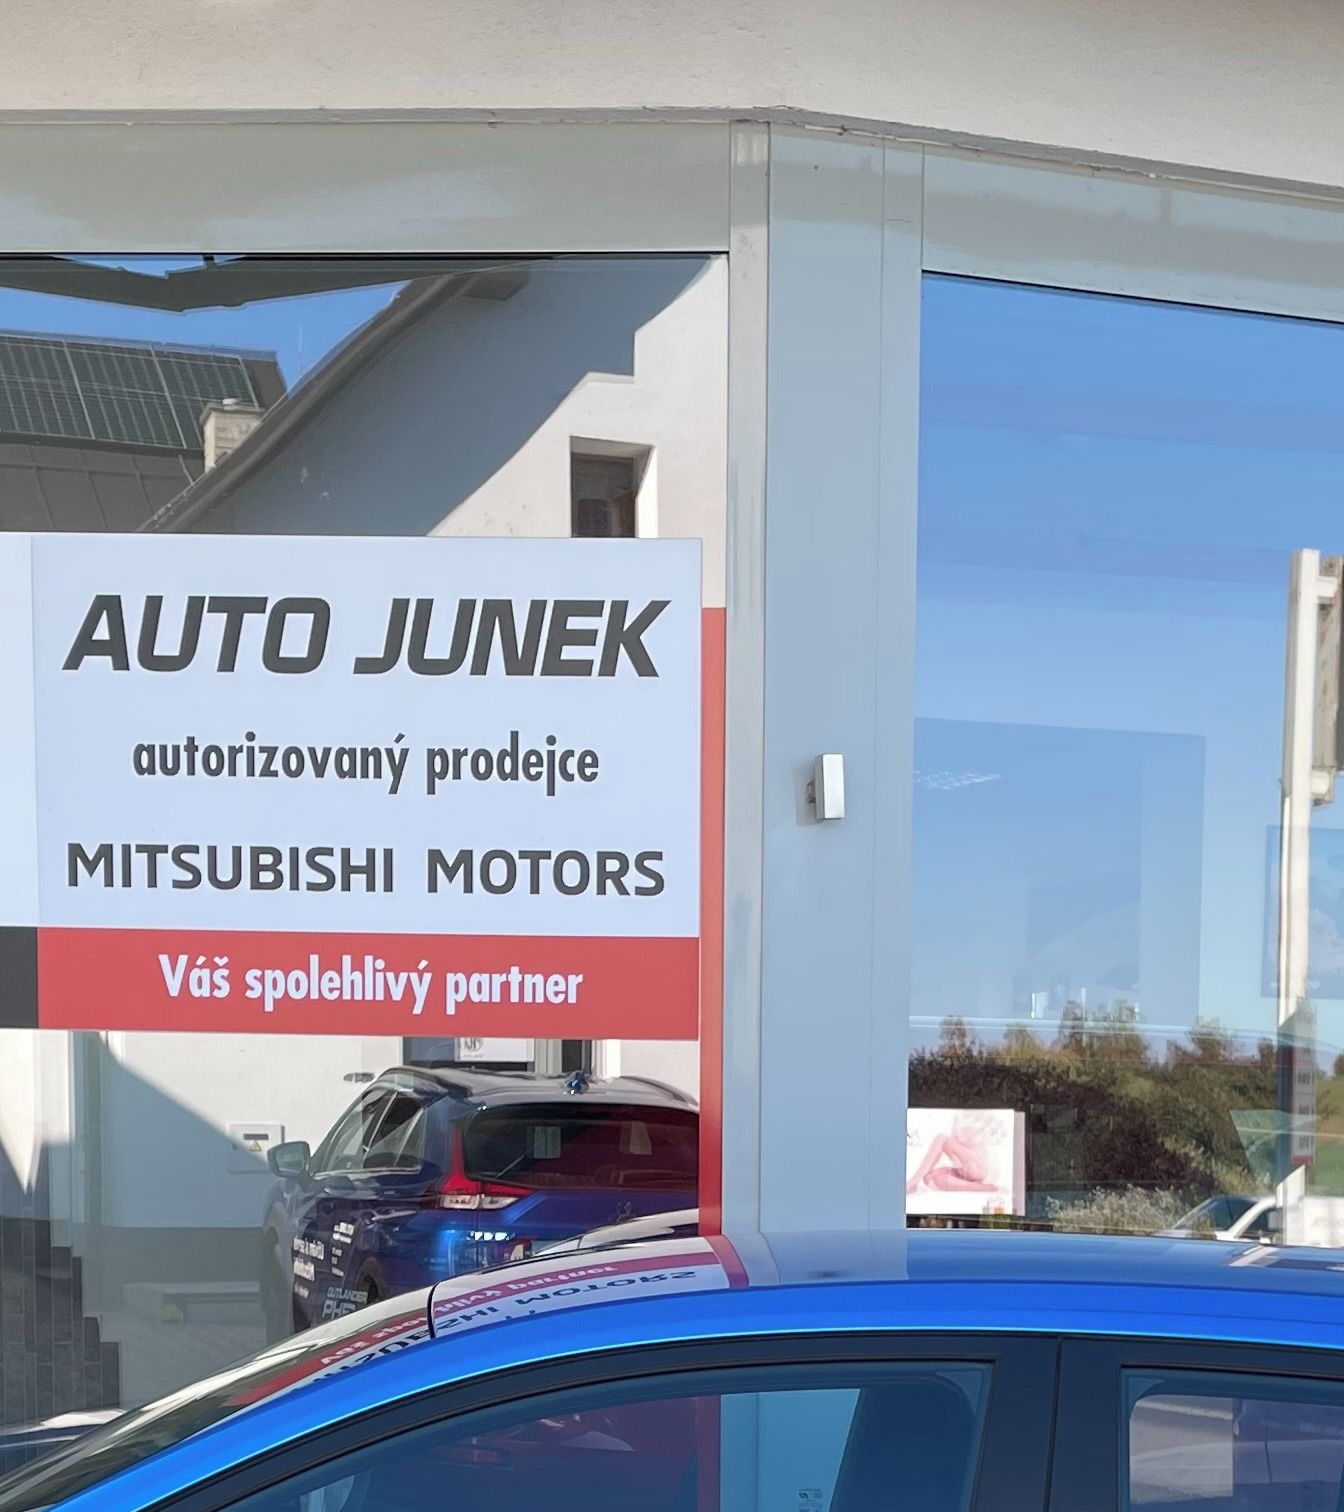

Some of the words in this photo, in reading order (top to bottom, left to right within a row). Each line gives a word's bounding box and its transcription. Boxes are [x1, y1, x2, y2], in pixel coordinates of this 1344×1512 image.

[62, 595, 328, 674] AUTO
[353, 597, 670, 677] JUNEK
[132, 733, 410, 794] autorizovaný
[426, 731, 599, 796] prodejce
[67, 842, 394, 893] MITSUBISHI
[427, 849, 665, 897] MOTORS
[158, 951, 231, 1000] Váš
[244, 952, 432, 1015] spolehlivý
[445, 964, 584, 1016] partner
